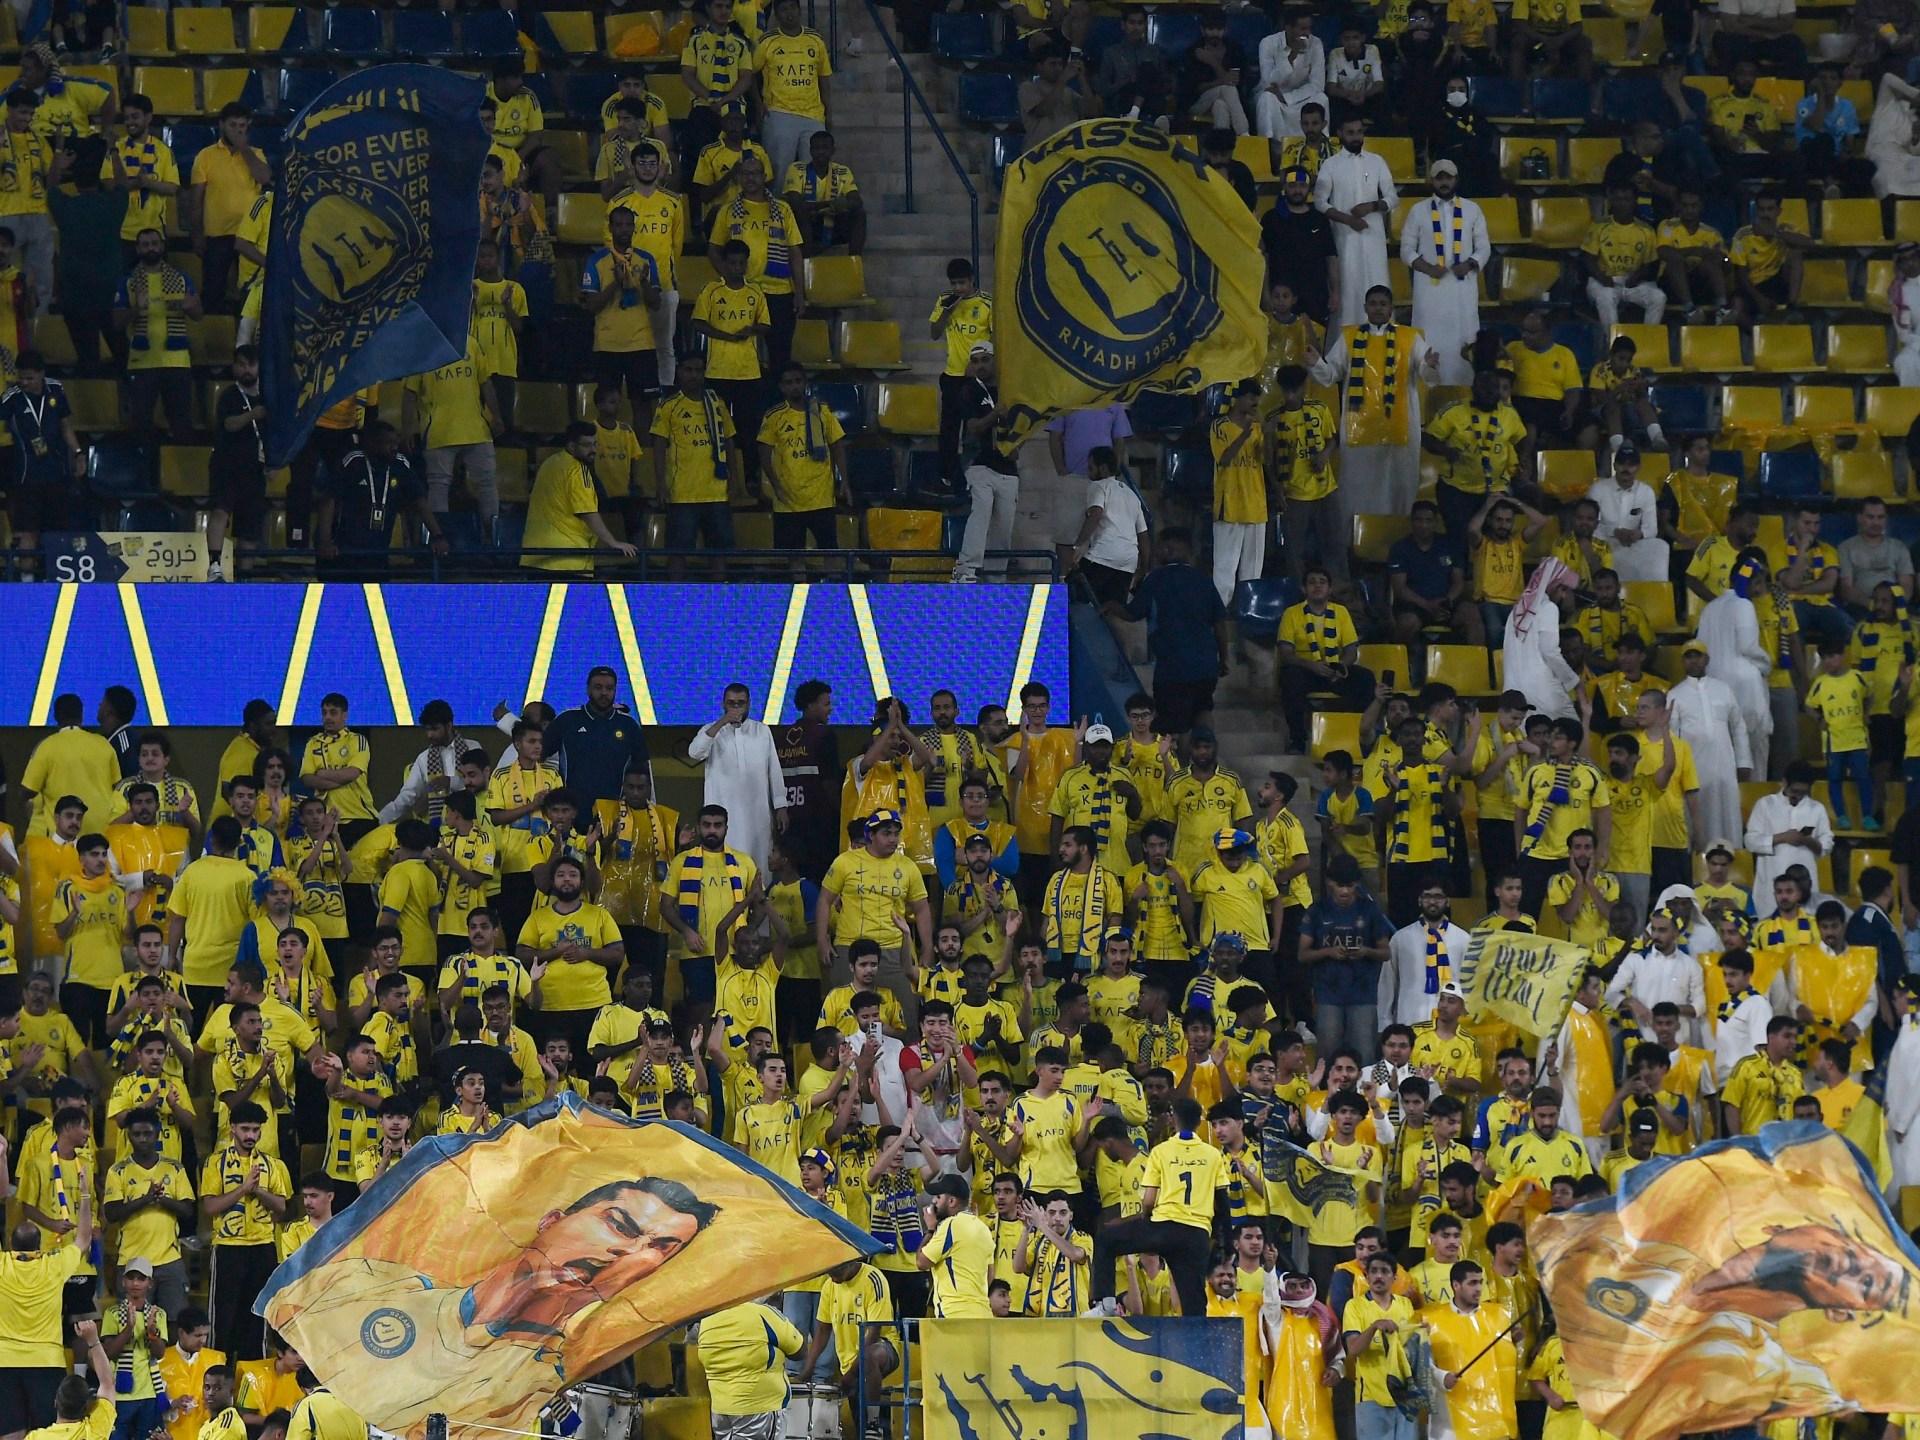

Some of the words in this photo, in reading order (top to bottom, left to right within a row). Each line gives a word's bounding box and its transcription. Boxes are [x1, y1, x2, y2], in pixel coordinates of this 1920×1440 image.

[366, 127, 431, 156] EVER
[371, 152, 430, 181] EVER
[301, 176, 373, 204] NASSR
[1058, 326, 1136, 371] RIYADH
[434, 366, 473, 381] KAFD
[146, 544, 196, 567] خروج
[56, 554, 96, 583] S8
[1828, 706, 1861, 718] KAFD
[1185, 798, 1227, 813] KAFD
[857, 884, 901, 897] KAFD
[1322, 935, 1365, 948] KAFD
[1031, 1003, 1058, 1017] rasil
[1125, 1078, 1142, 1100] 7
[1036, 1127, 1065, 1140] KAFD
[1169, 1156, 1184, 1167] رقم
[1185, 1158, 1207, 1168] اللاعب
[1179, 1171, 1192, 1206] 1
